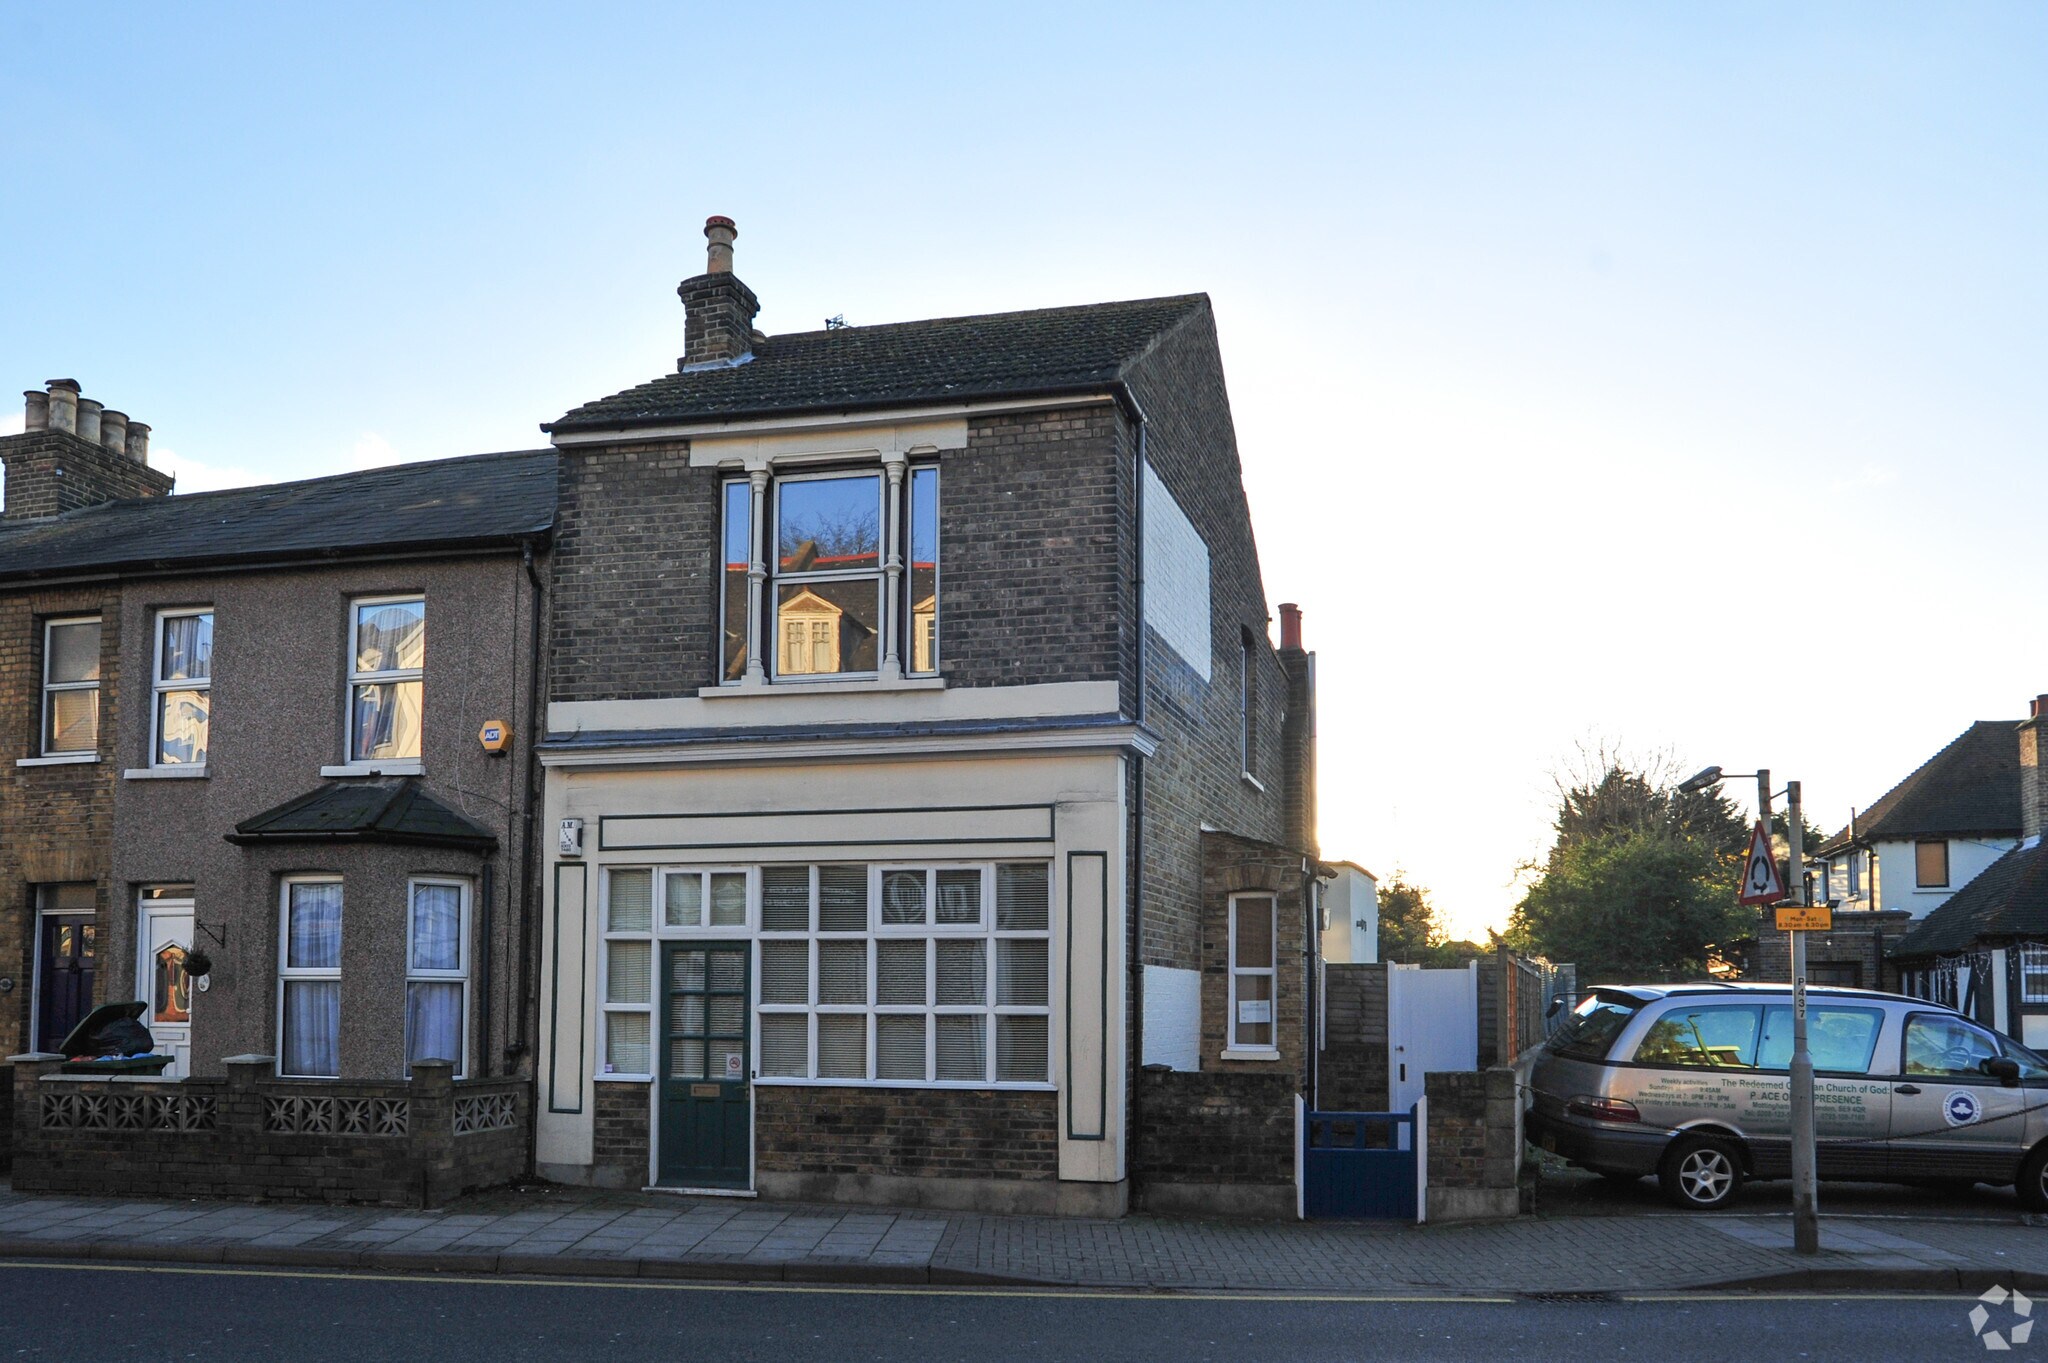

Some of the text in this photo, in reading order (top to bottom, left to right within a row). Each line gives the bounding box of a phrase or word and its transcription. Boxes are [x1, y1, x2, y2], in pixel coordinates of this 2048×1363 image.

[485, 730, 499, 739] ADT
[1660, 1077, 1681, 1085] Weekly
[1721, 1078, 1737, 1087] The
[1740, 1079, 1784, 1089] Redeemed
[1826, 1083, 1857, 1093] Church
[1859, 1085, 1868, 1094] of
[1814, 1094, 1862, 1104] PRESENCE
